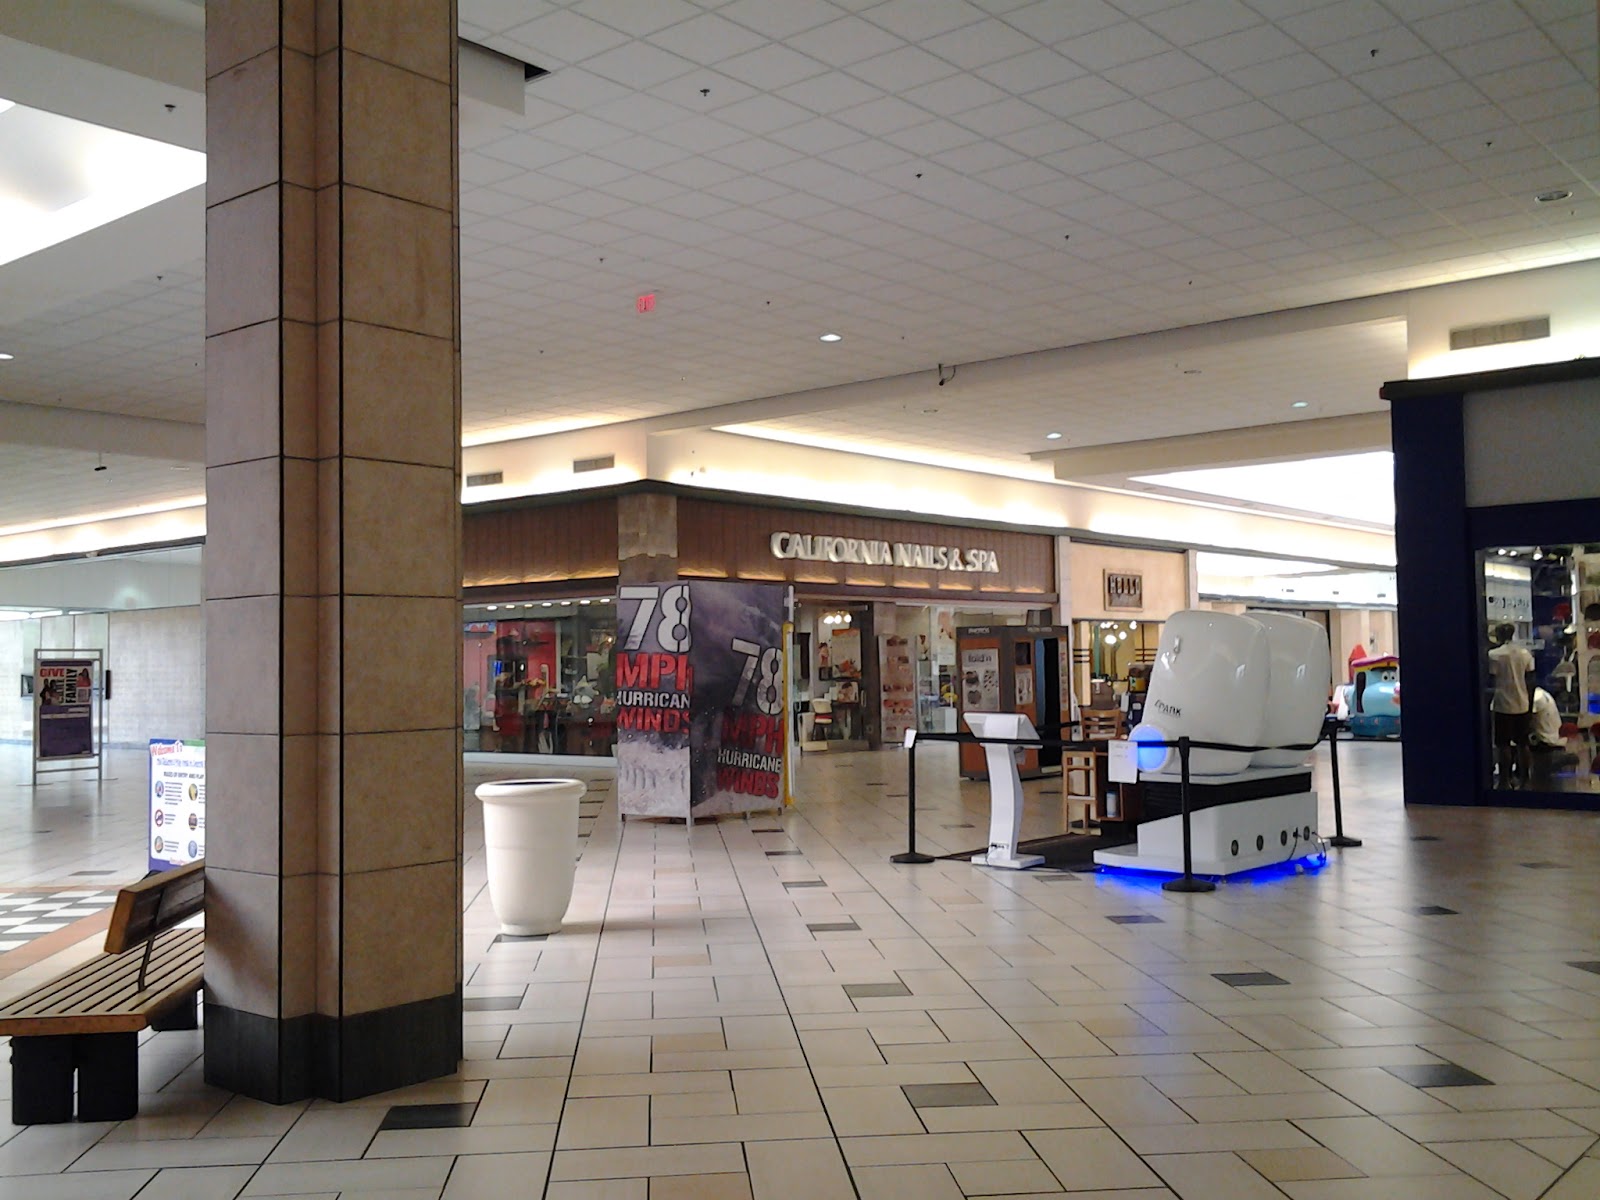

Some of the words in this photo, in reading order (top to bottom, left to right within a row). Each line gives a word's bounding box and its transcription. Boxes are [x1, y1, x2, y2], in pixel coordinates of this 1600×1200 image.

[770, 531, 894, 566] CALIFORNIA
[894, 542, 948, 570] NAILS
[949, 547, 965, 571] &
[966, 548, 999, 573] SPA
[619, 585, 692, 653] 78
[40, 668, 65, 678] GIVE
[65, 668, 78, 703] FAMILY
[731, 637, 784, 716] 78
[617, 690, 691, 710] HURRICAN
[721, 707, 784, 756] MPH
[717, 749, 783, 774] HURRICANE
[716, 766, 780, 799] WINDS
